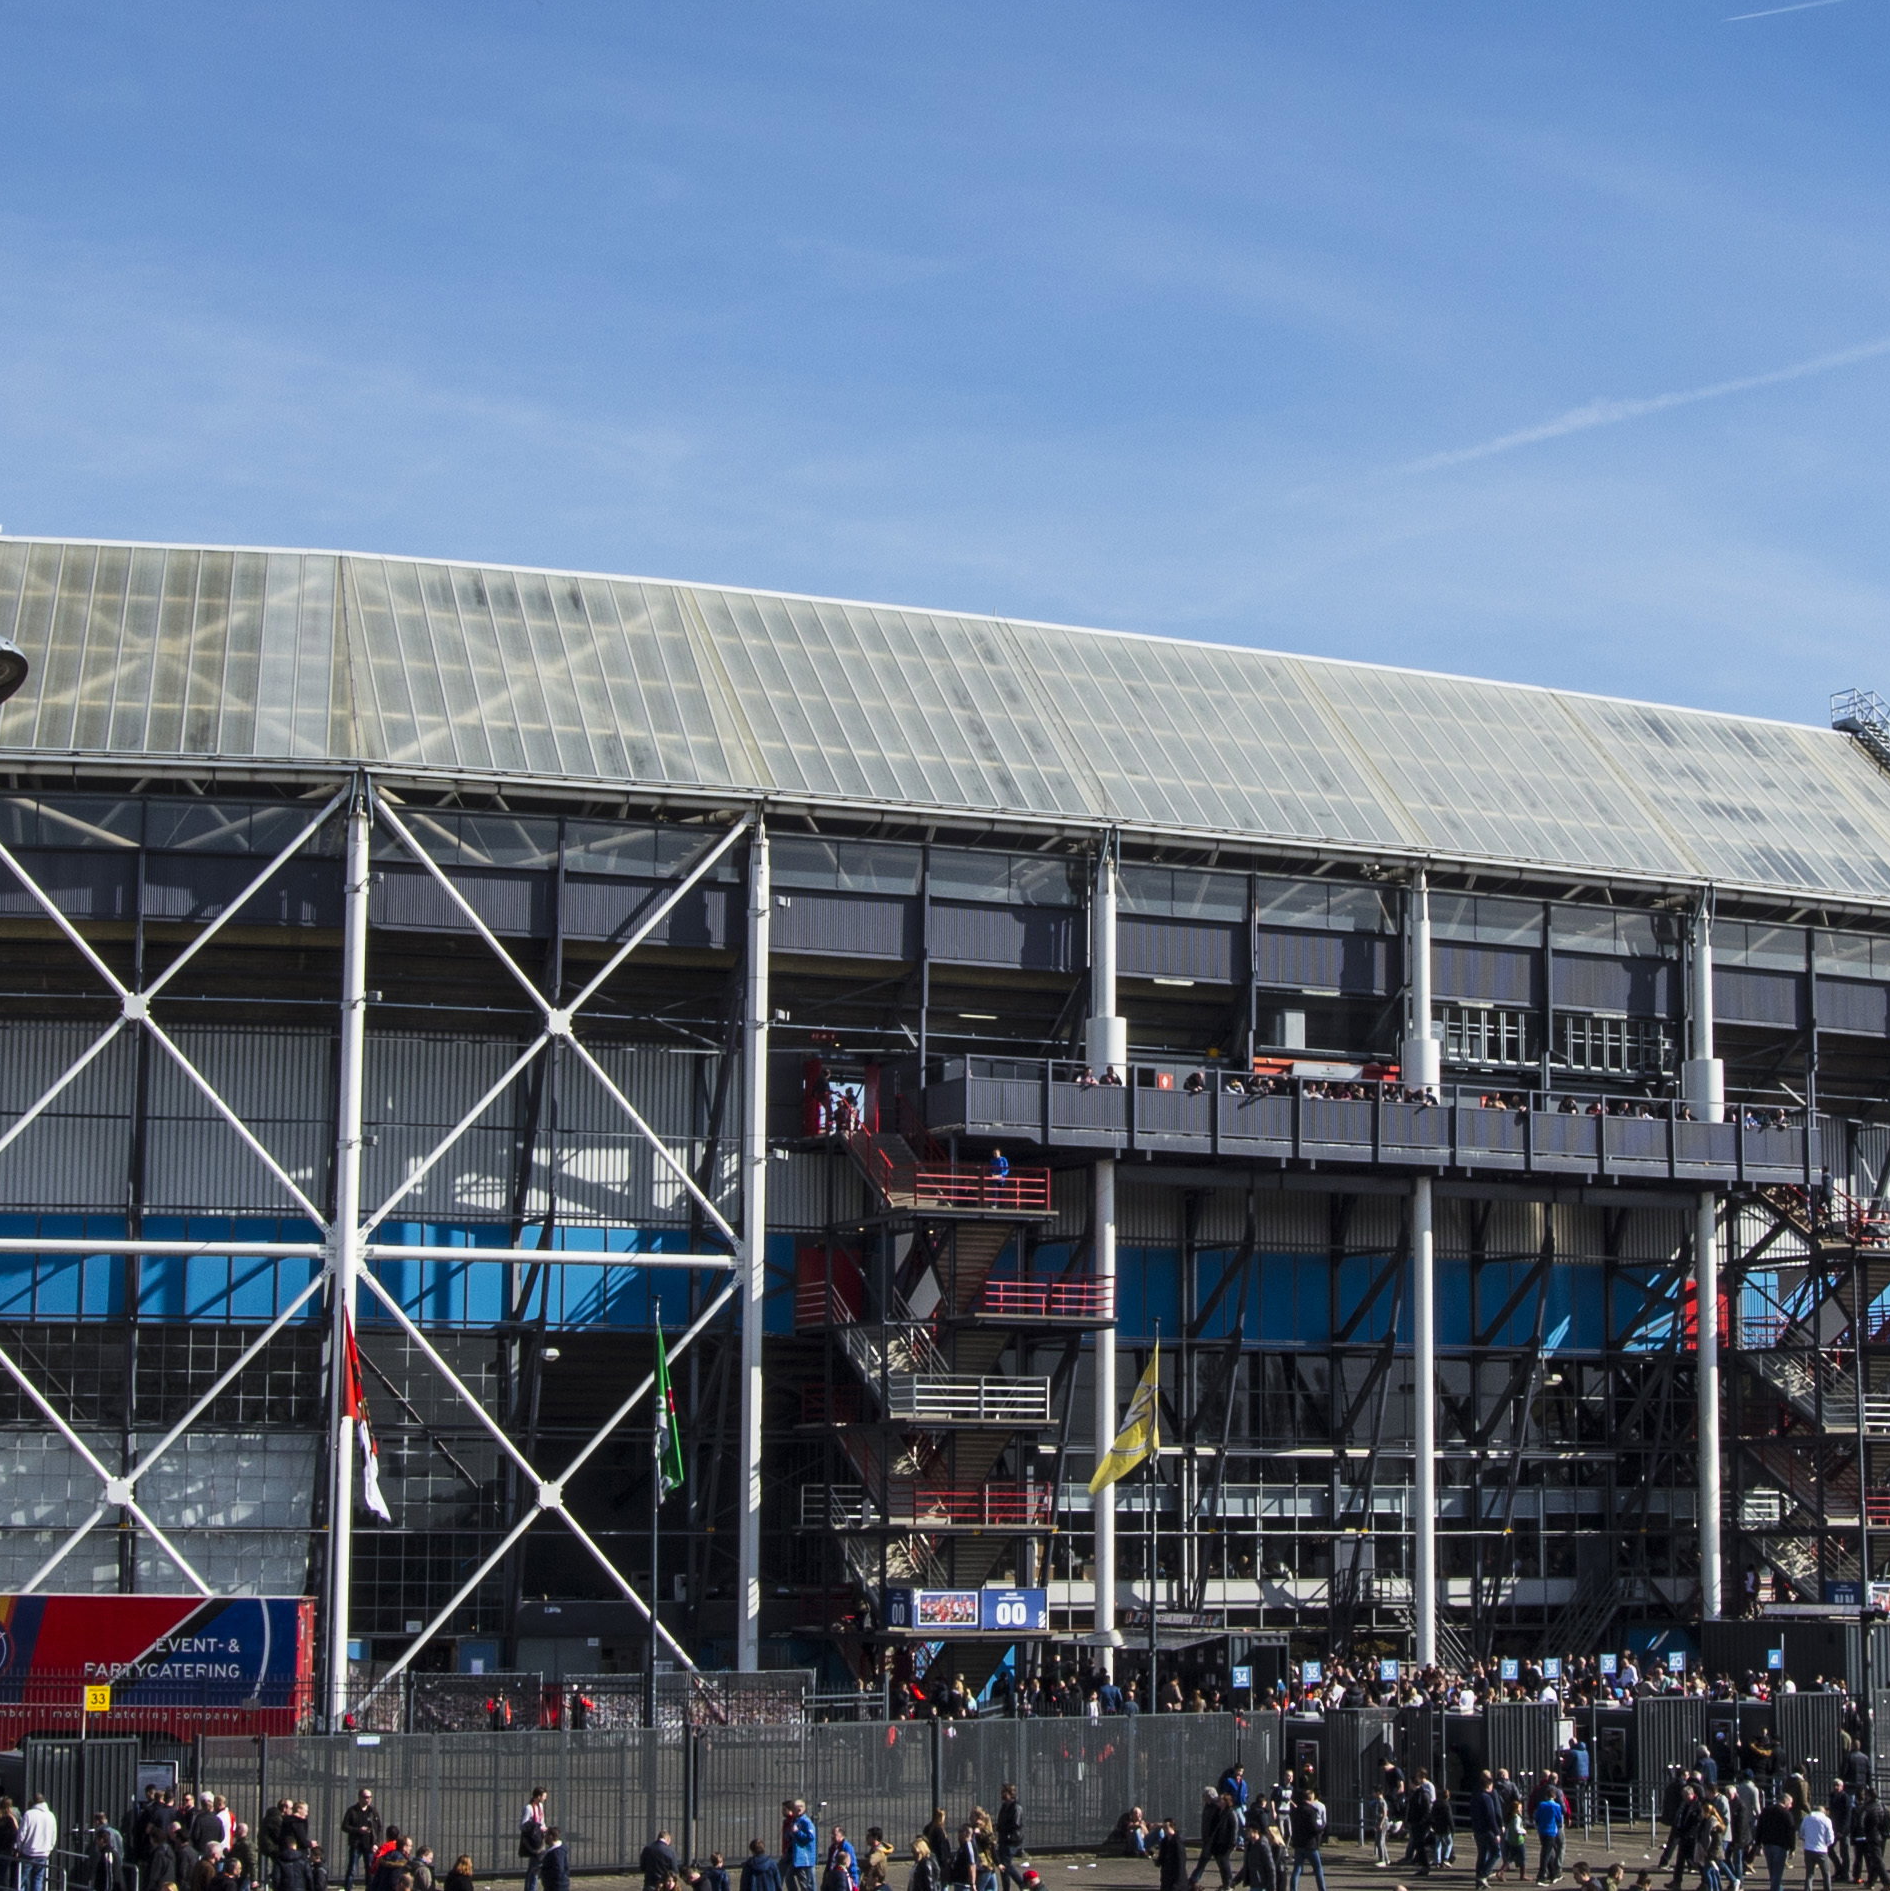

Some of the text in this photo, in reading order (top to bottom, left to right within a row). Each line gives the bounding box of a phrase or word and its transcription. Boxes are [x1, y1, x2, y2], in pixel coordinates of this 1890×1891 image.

[155, 1638, 241, 1653] EVENT- &
[1604, 1659, 1614, 1669] 39
[1670, 1656, 1683, 1667] 40
[1306, 1666, 1318, 1678] 35
[1384, 1665, 1395, 1677] 36
[1505, 1665, 1516, 1675] 37
[1235, 1672, 1247, 1683] 34
[91, 1694, 106, 1705] 33
[53, 1710, 101, 1718] moble
[107, 1710, 168, 1722] catering
